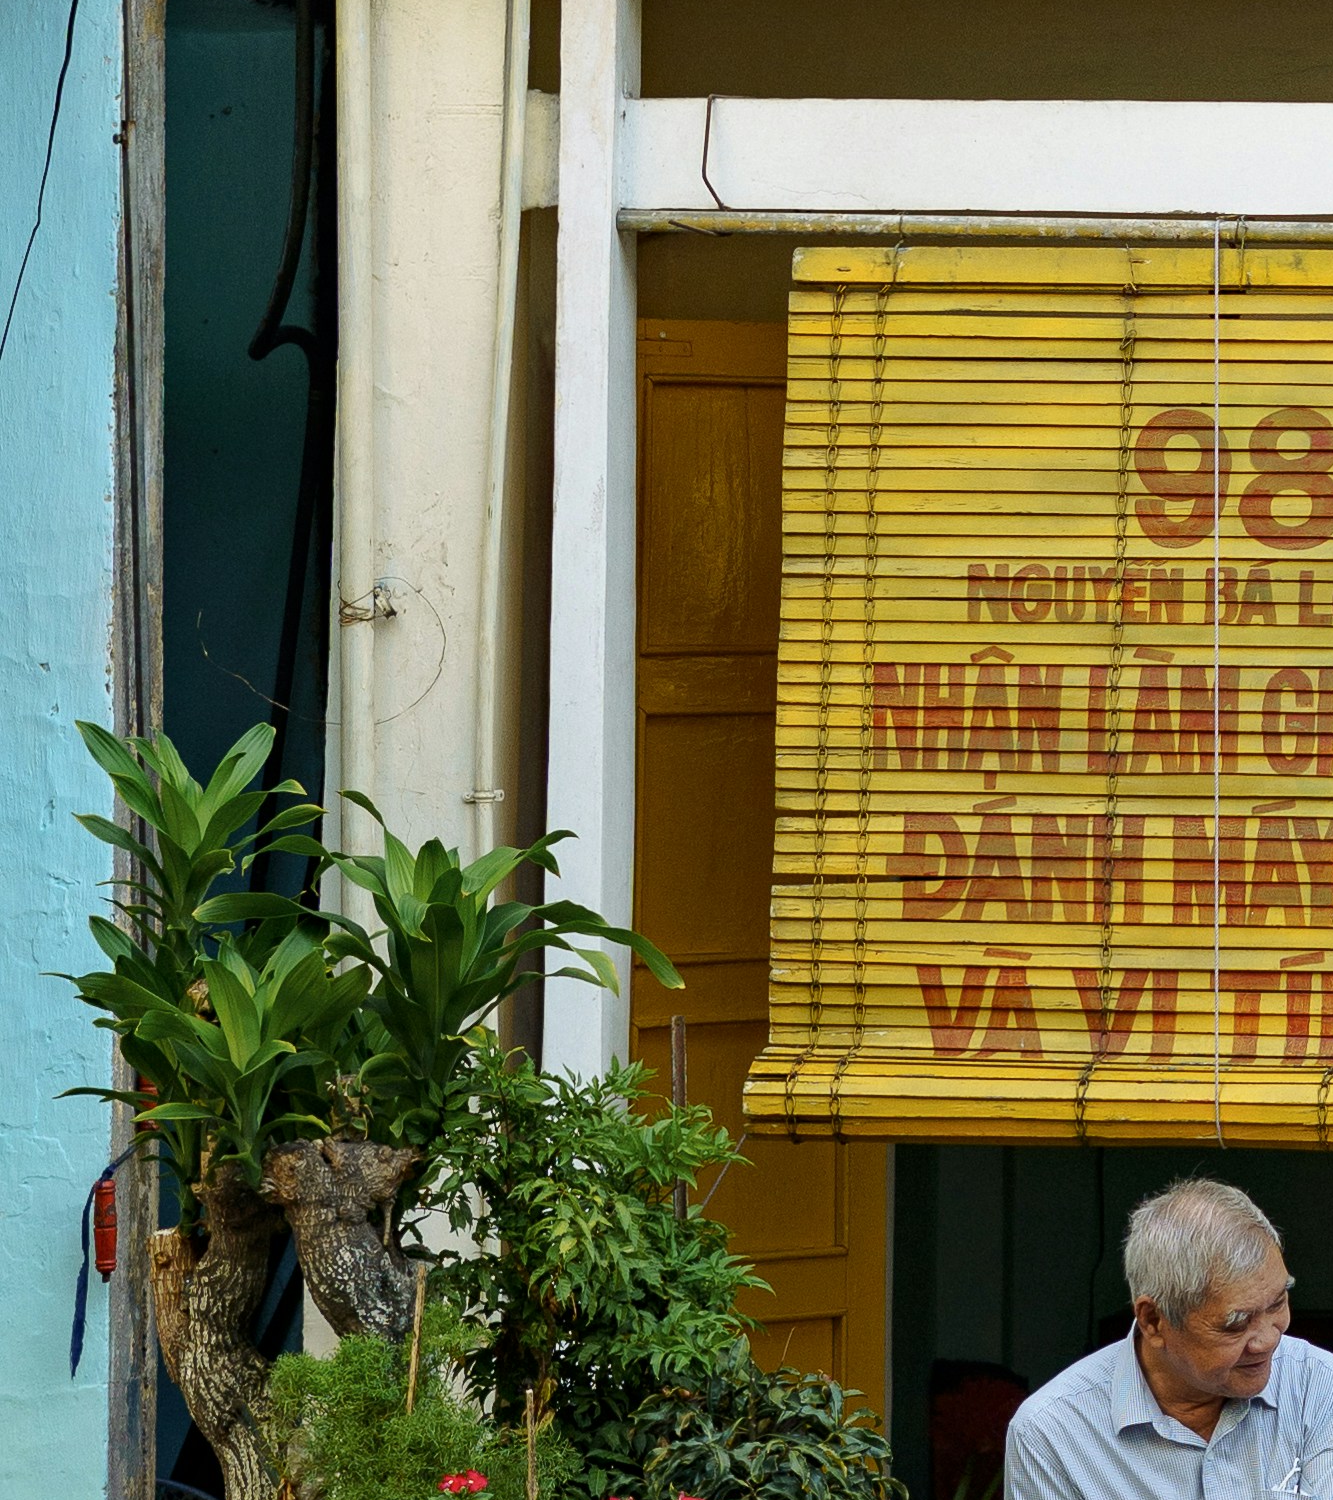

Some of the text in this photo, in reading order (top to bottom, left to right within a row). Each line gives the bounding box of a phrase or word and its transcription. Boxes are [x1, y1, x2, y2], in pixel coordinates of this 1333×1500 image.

[966, 559, 1184, 625] NGUYỄN
[1205, 559, 1277, 625] BÁ
[872, 645, 1063, 790] NHẬN
[1087, 646, 1240, 774] LÀM
[886, 795, 1145, 922] ĐÁNH
[916, 947, 1045, 1059] VÀ
[1072, 968, 1179, 1063] VI
